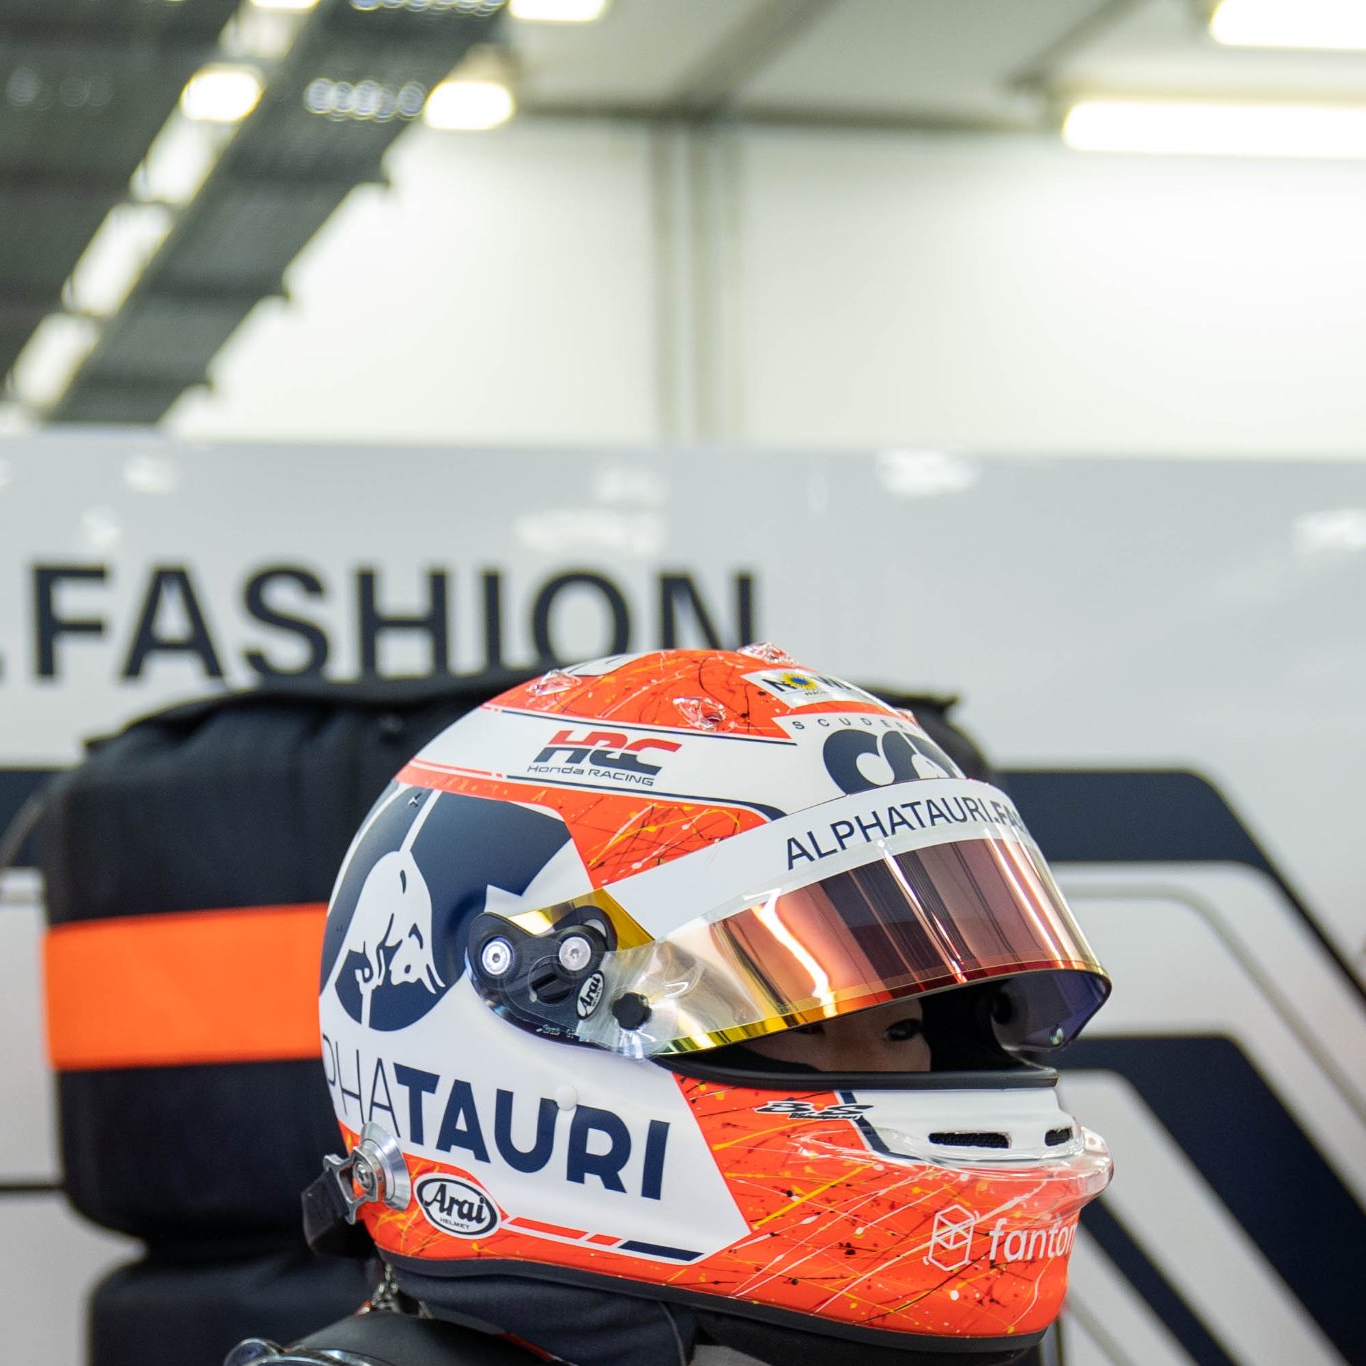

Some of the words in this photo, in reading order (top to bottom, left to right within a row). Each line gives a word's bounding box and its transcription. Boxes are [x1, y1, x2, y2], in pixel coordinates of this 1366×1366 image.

[533, 729, 683, 776] HRC
[526, 765, 584, 775] Honda
[587, 768, 657, 787] RACING
[424, 1183, 487, 1224] Arai
[440, 1217, 470, 1230] HELMET
